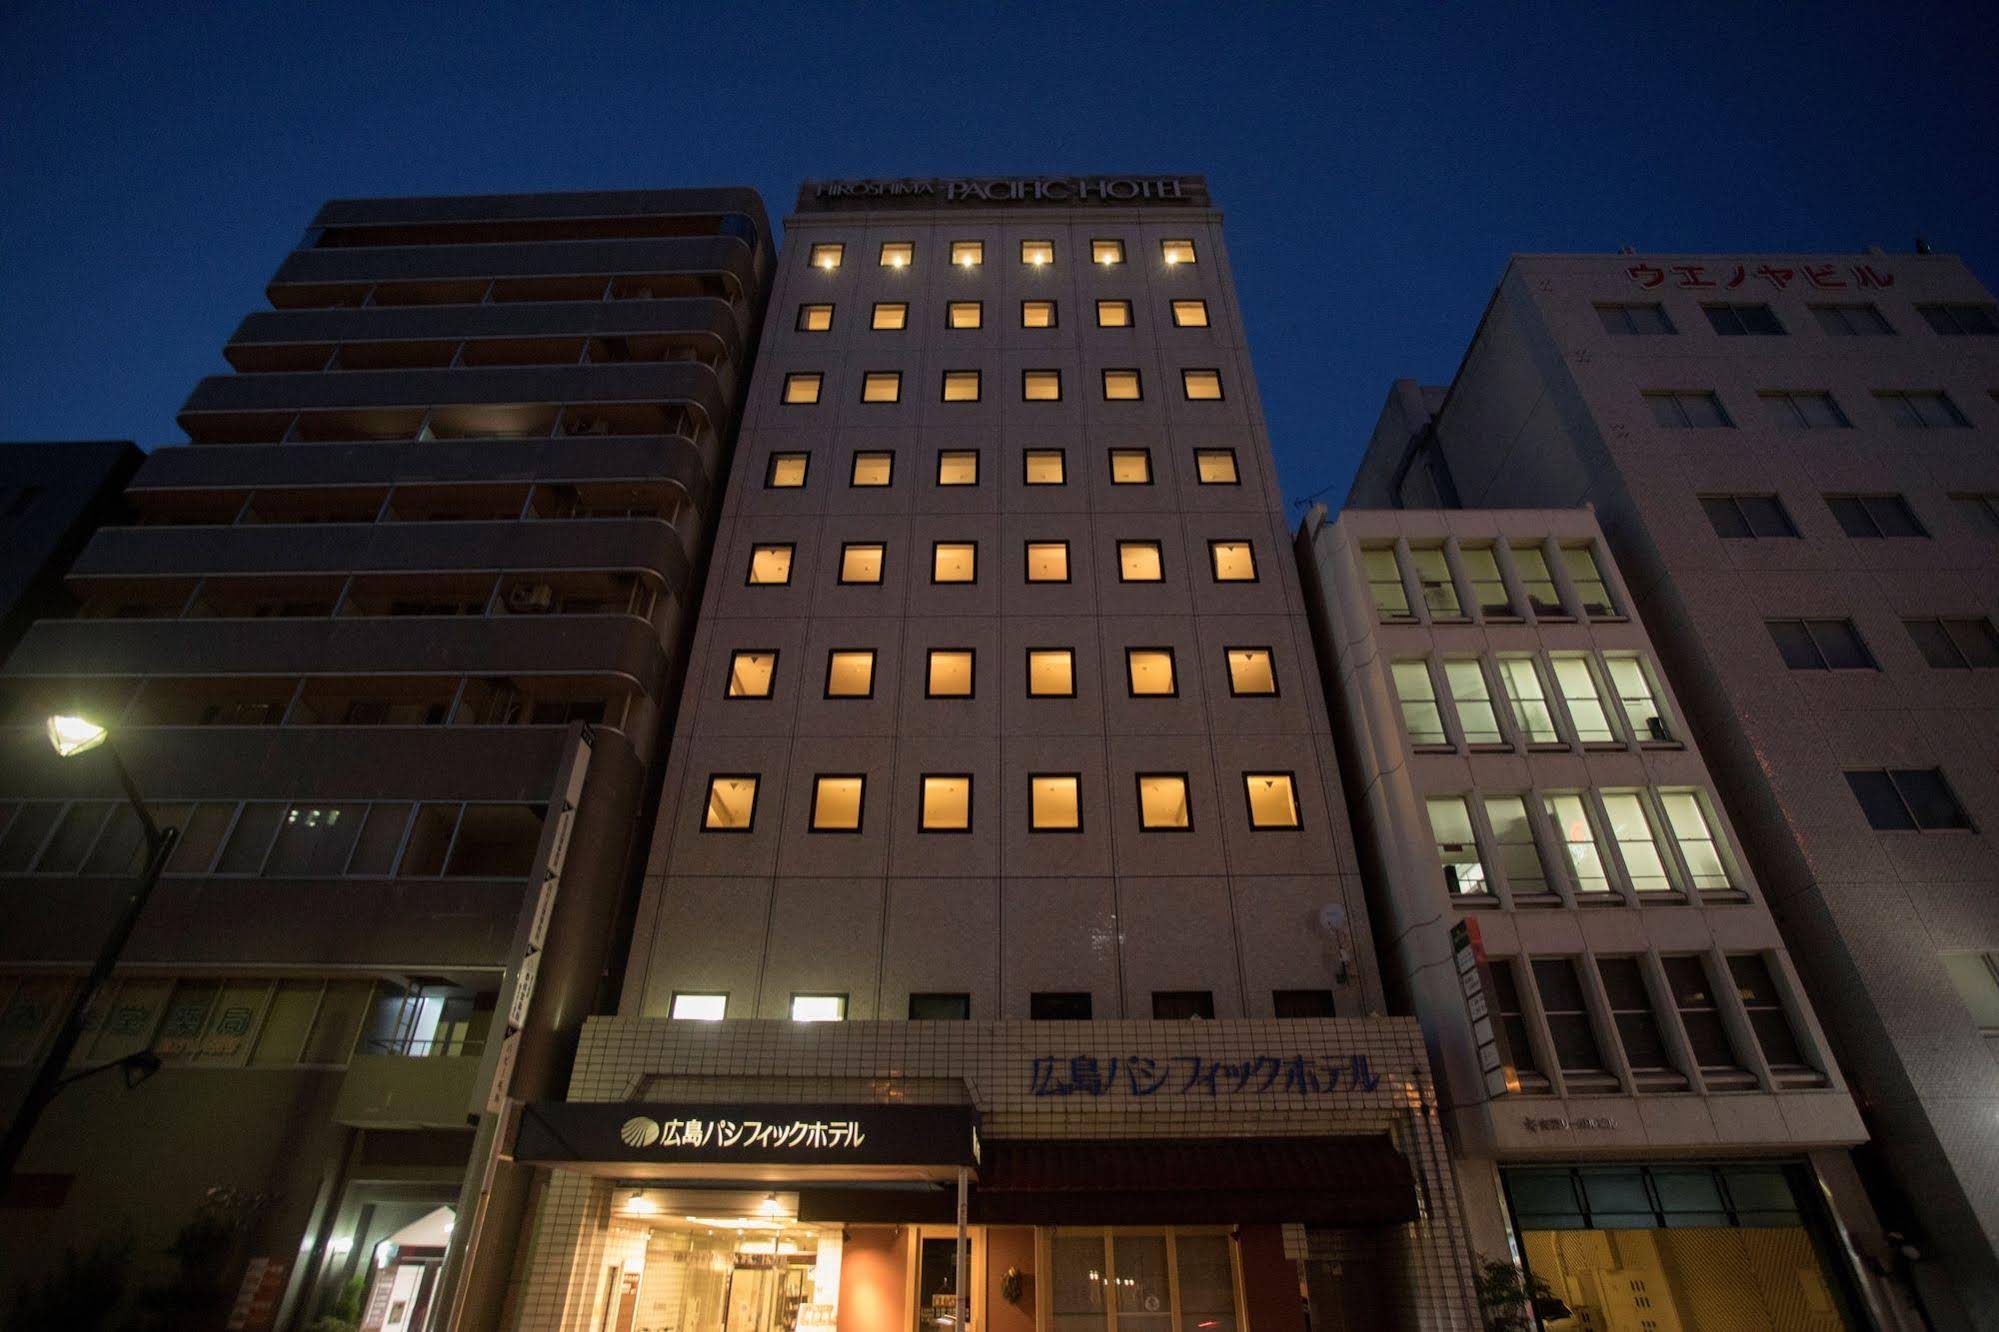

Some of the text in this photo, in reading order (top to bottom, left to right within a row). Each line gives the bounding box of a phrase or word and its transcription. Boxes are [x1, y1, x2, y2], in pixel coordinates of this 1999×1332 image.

[816, 179, 1192, 201] HIROSHIMA PACIFIC HOTEL
[1625, 264, 1894, 290] ウエノヤビル
[1032, 1054, 1380, 1096] 広島パシフィックホテル
[660, 1118, 865, 1149] 広島パシフィックホテル
